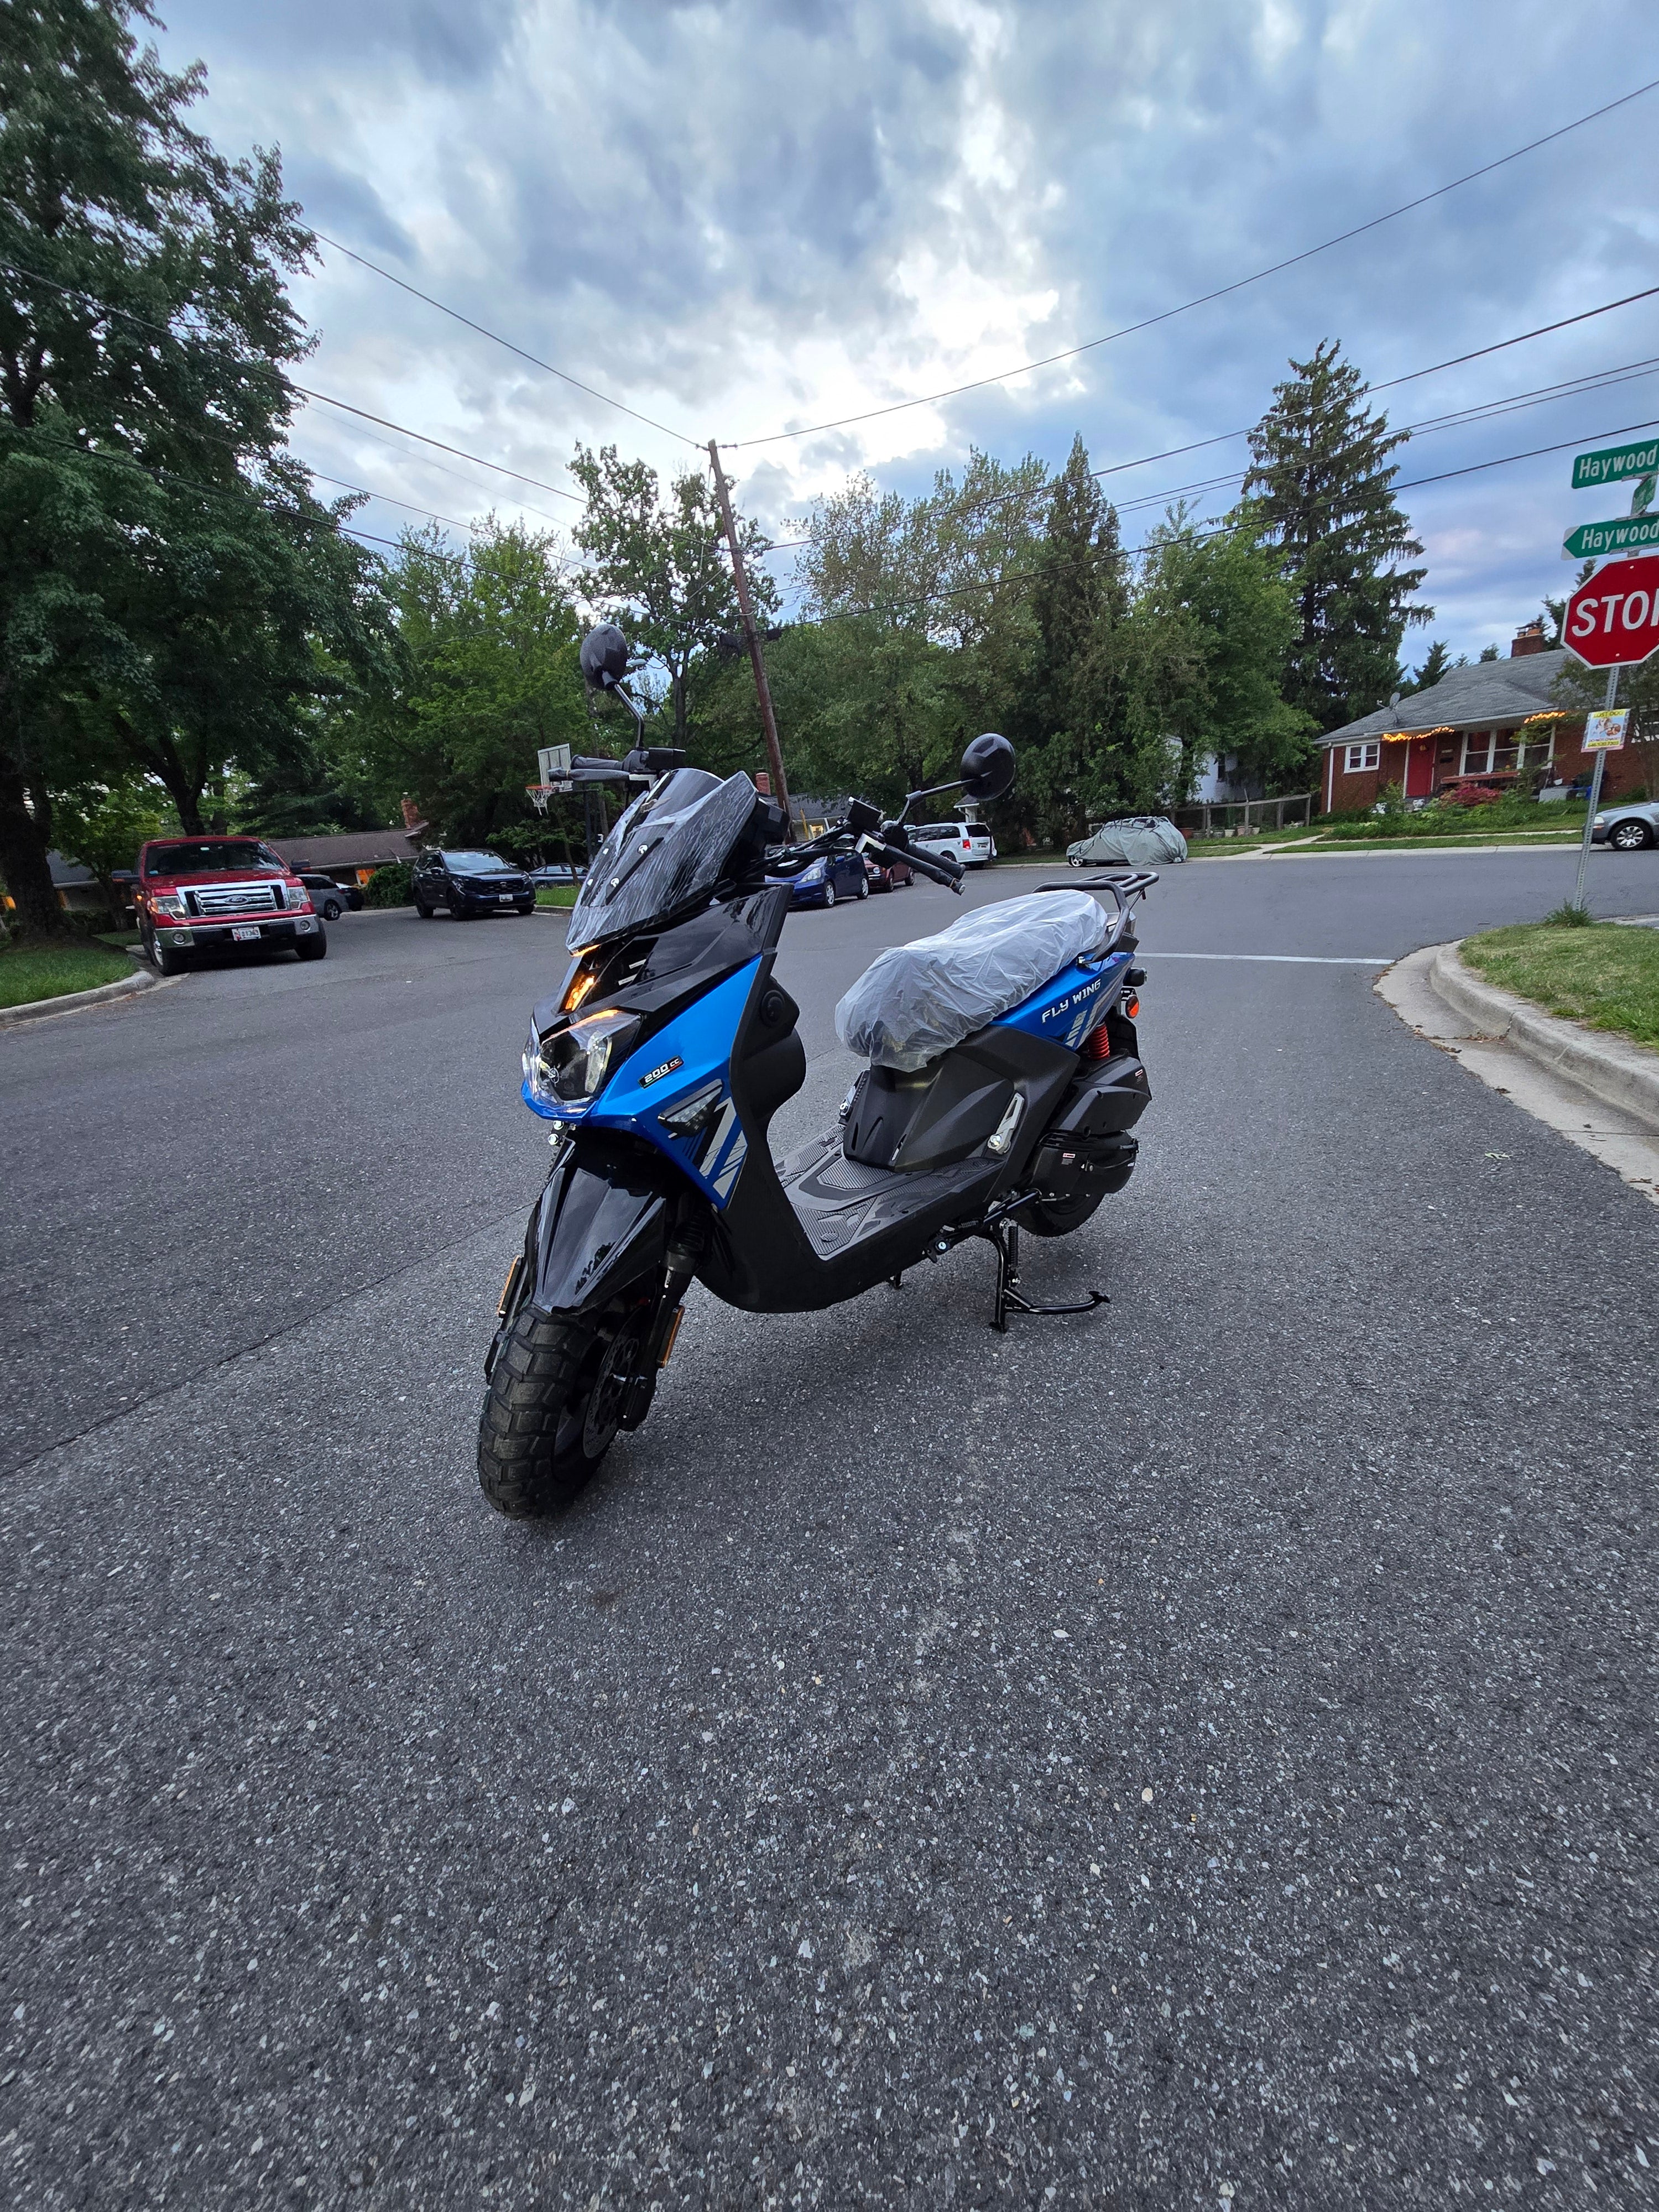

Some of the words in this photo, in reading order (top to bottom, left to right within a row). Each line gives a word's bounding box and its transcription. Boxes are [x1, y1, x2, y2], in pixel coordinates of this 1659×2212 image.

[1579, 444, 1658, 480] Haywood
[1582, 519, 1659, 551] Haywood
[1042, 999, 1069, 1023] FLY
[1072, 978, 1101, 1004] WING
[644, 1063, 669, 1083] 200
